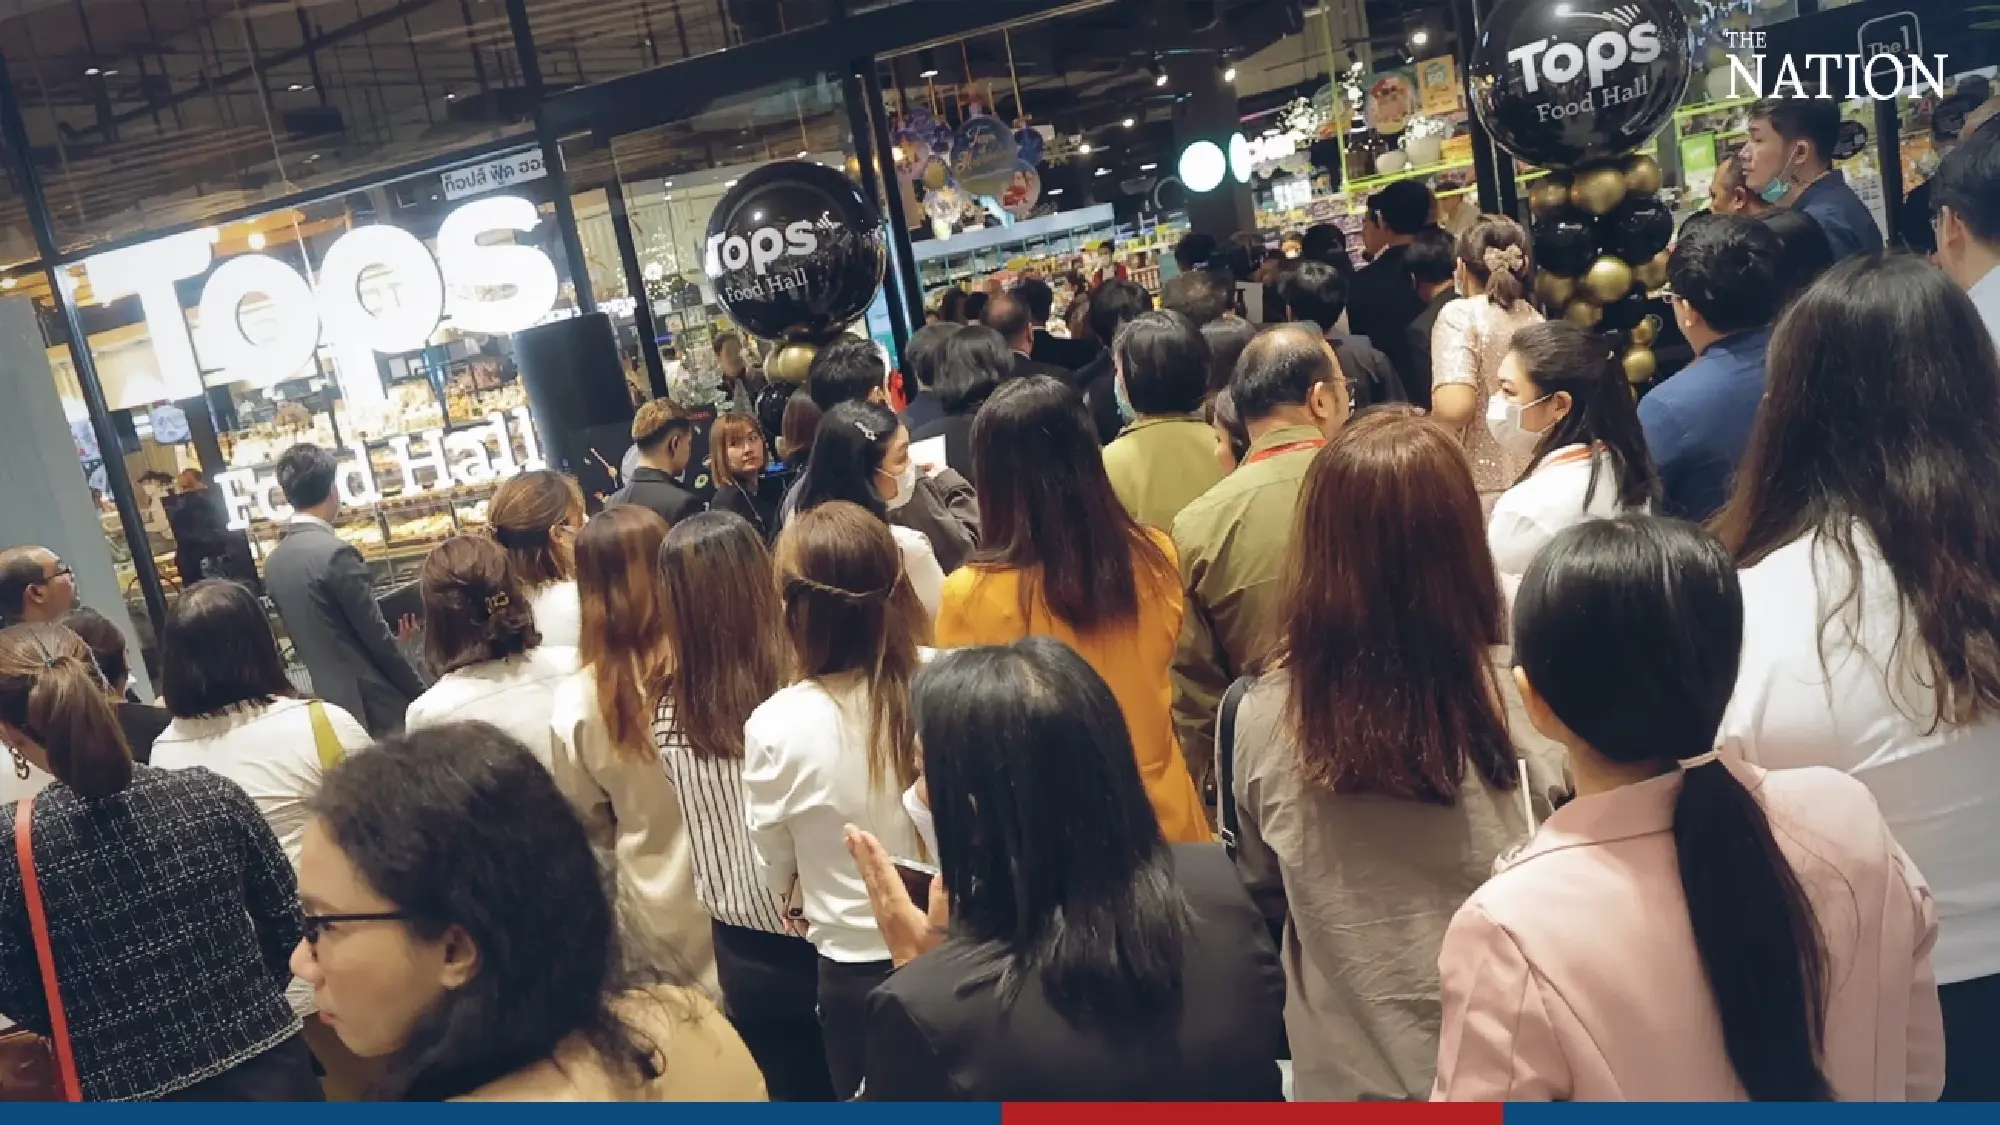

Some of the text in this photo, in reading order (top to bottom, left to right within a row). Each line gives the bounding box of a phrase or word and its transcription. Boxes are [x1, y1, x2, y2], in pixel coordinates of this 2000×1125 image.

[1507, 22, 1662, 93] Tops
[1536, 75, 1649, 123] Food Hall
[705, 220, 818, 277] Tops
[84, 196, 559, 408] Tops
[725, 267, 809, 303] Food Hall
[387, 407, 547, 491] Hall
